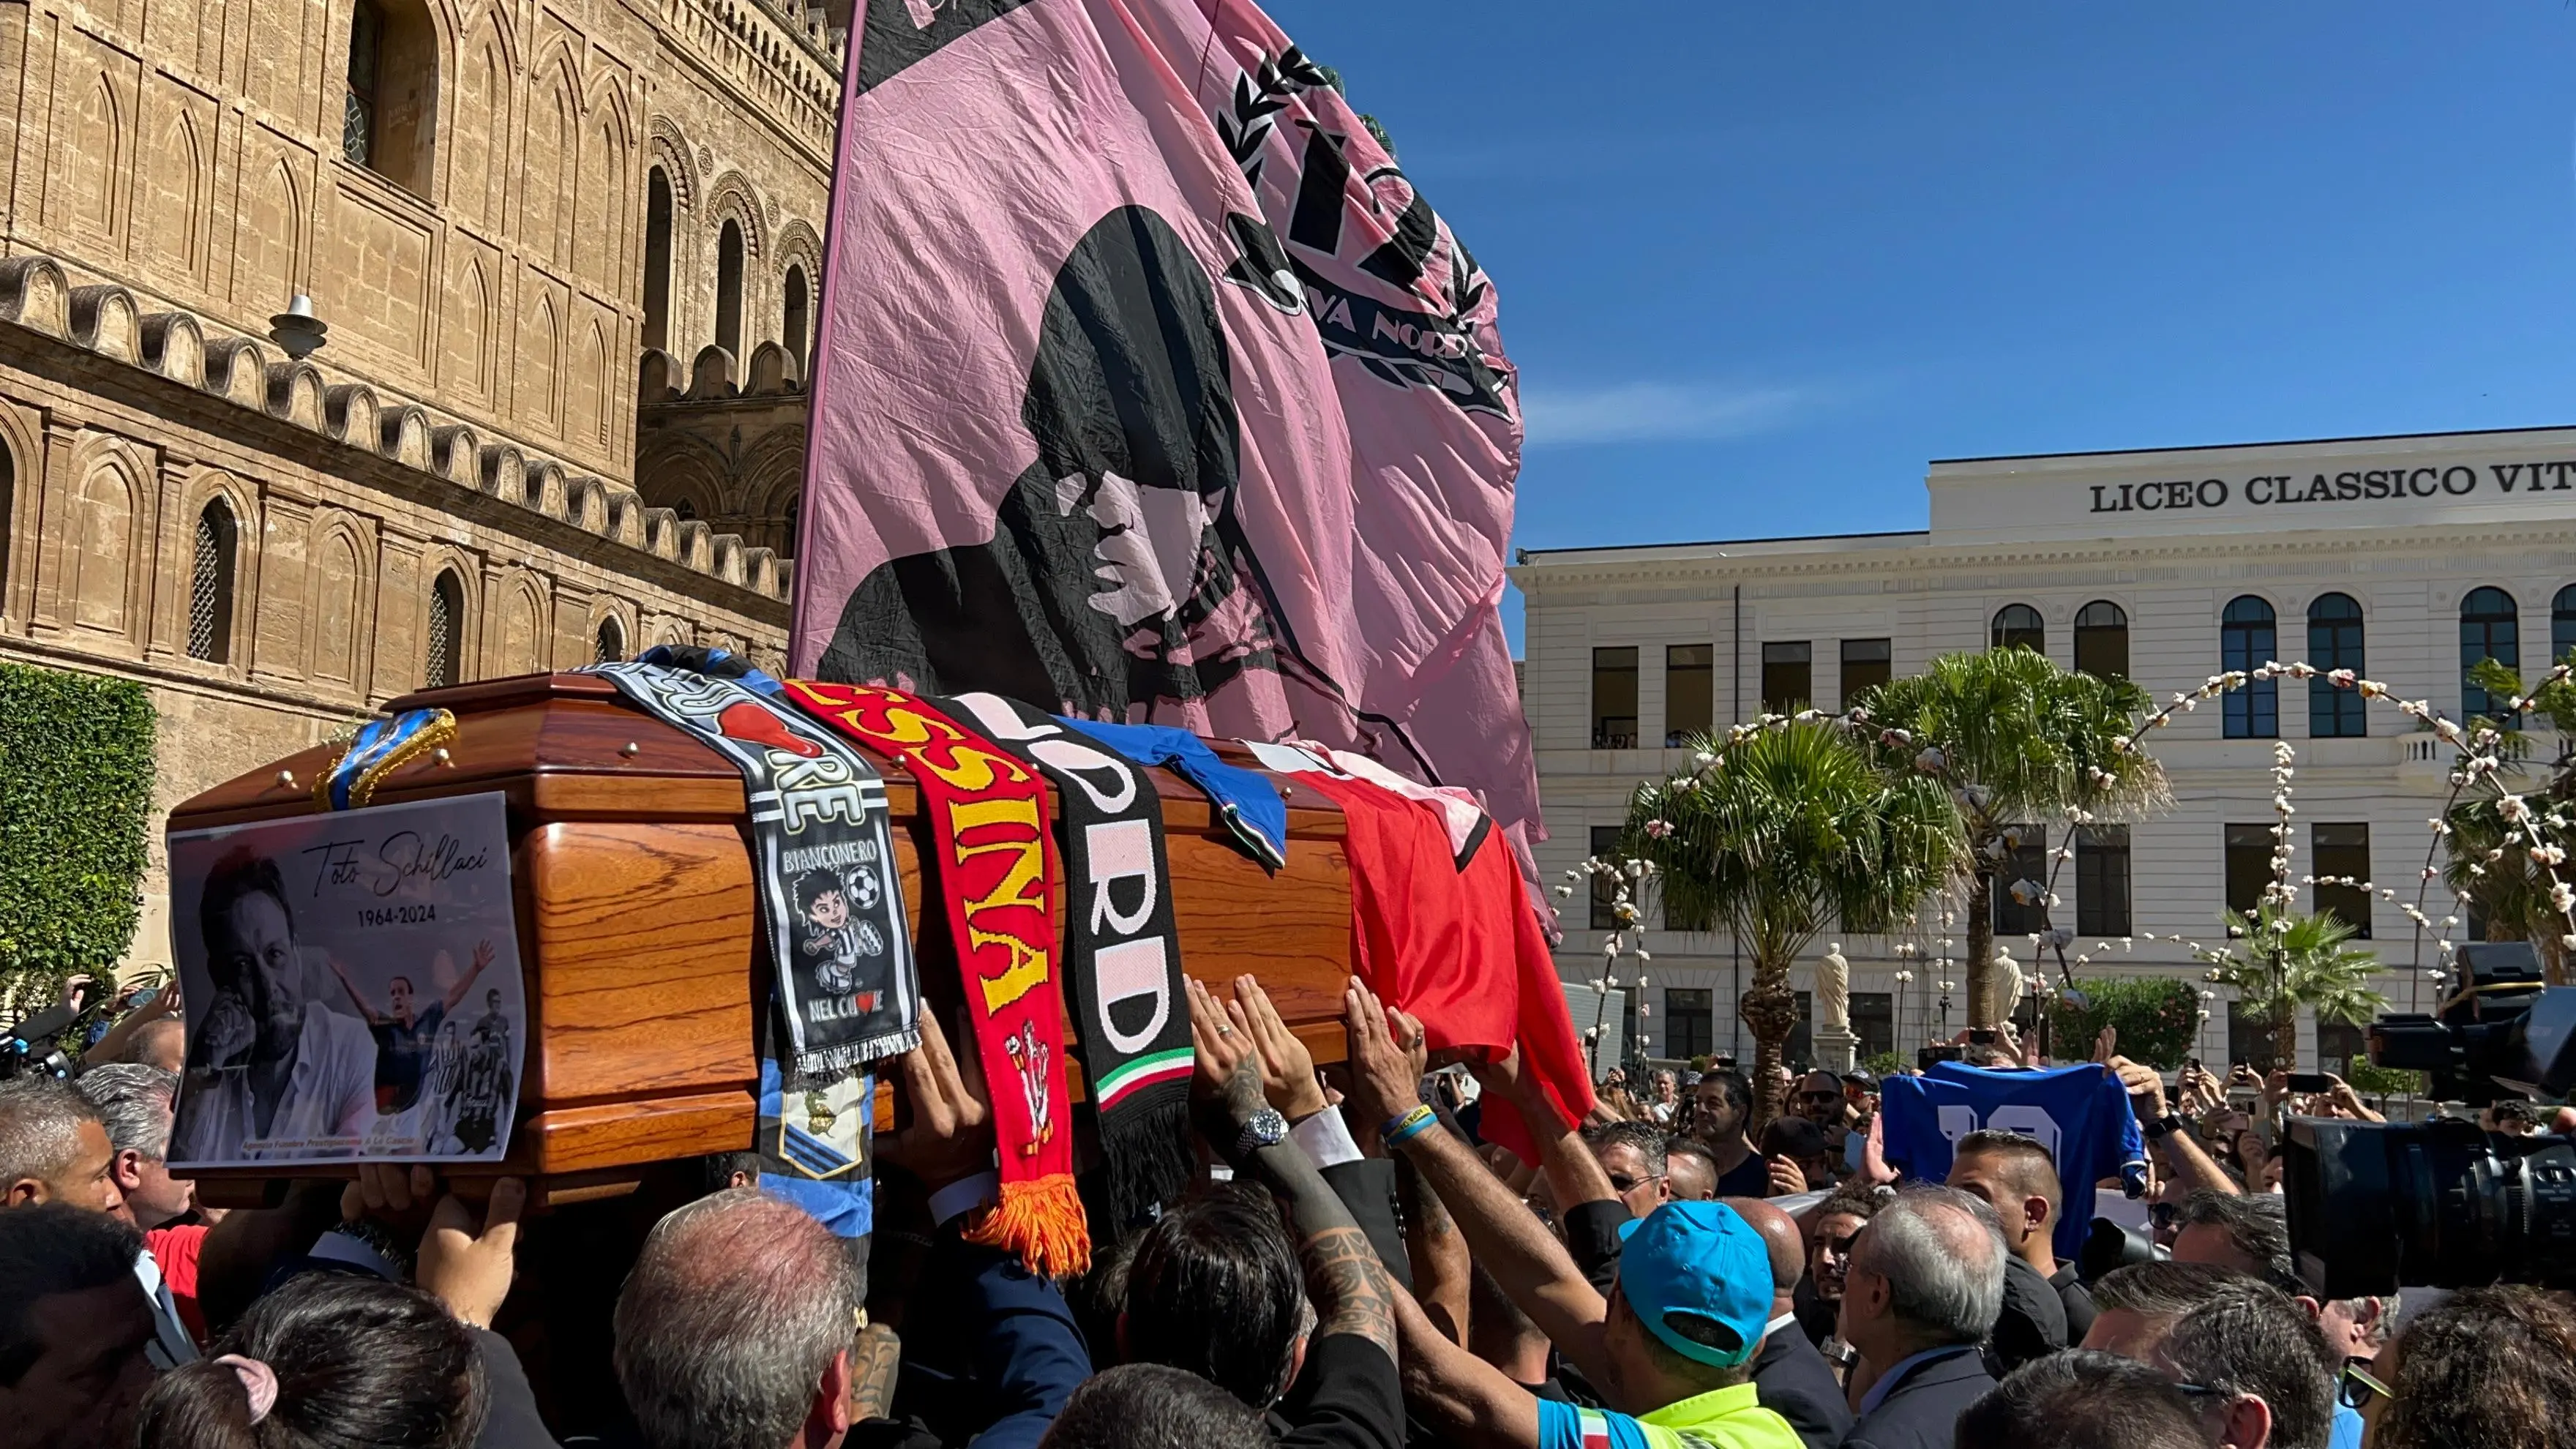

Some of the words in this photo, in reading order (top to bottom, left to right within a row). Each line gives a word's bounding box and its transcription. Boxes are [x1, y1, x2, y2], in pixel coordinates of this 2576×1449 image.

[1372, 311, 1467, 359] NORD
[2089, 478, 2228, 513] LICEO
[2244, 466, 2476, 506] CLASSICO
[2489, 460, 2576, 493] VIT
[373, 831, 487, 897] Schillaci
[782, 839, 877, 874] BIANCONERO
[358, 904, 436, 927] 1964-2024
[808, 998, 838, 1023] NEL
